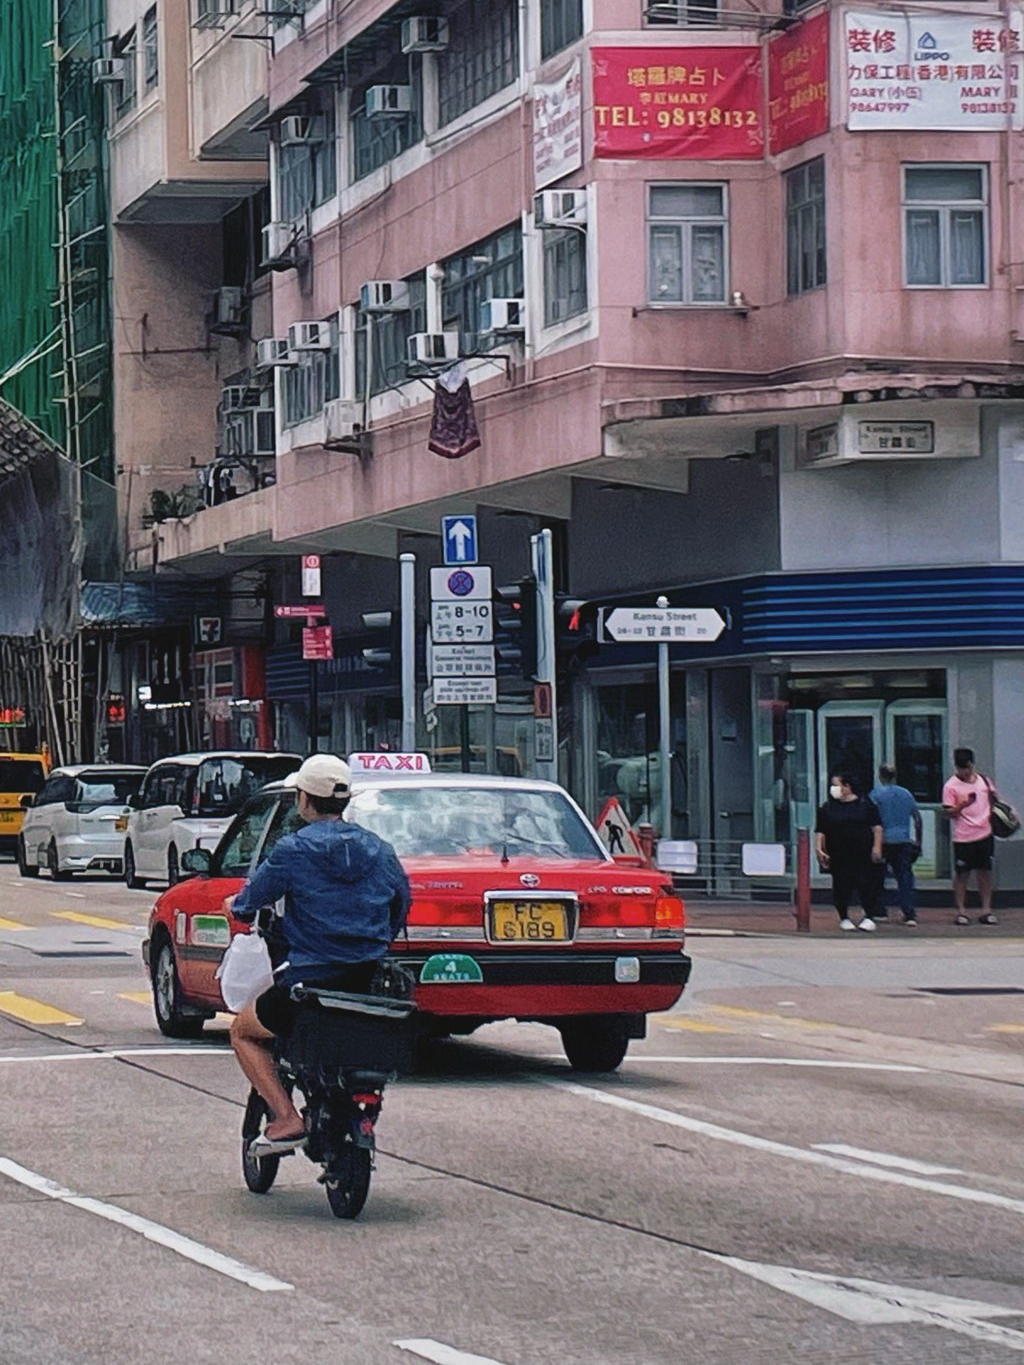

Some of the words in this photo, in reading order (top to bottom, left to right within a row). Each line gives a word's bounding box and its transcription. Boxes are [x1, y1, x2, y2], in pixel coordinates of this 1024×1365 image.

[848, 28, 896, 53] 裝修
[913, 51, 950, 62] LIPPO
[849, 87, 885, 98] GARY
[960, 87, 1001, 98] MARY
[594, 106, 649, 126] TEL:
[657, 107, 758, 129] 98138132
[454, 605, 489, 618] 8-10
[455, 625, 484, 637] 5-7
[358, 755, 423, 771] TAXI
[515, 904, 543, 921] FC
[503, 921, 556, 939] 6189
[444, 961, 457, 973] 4
